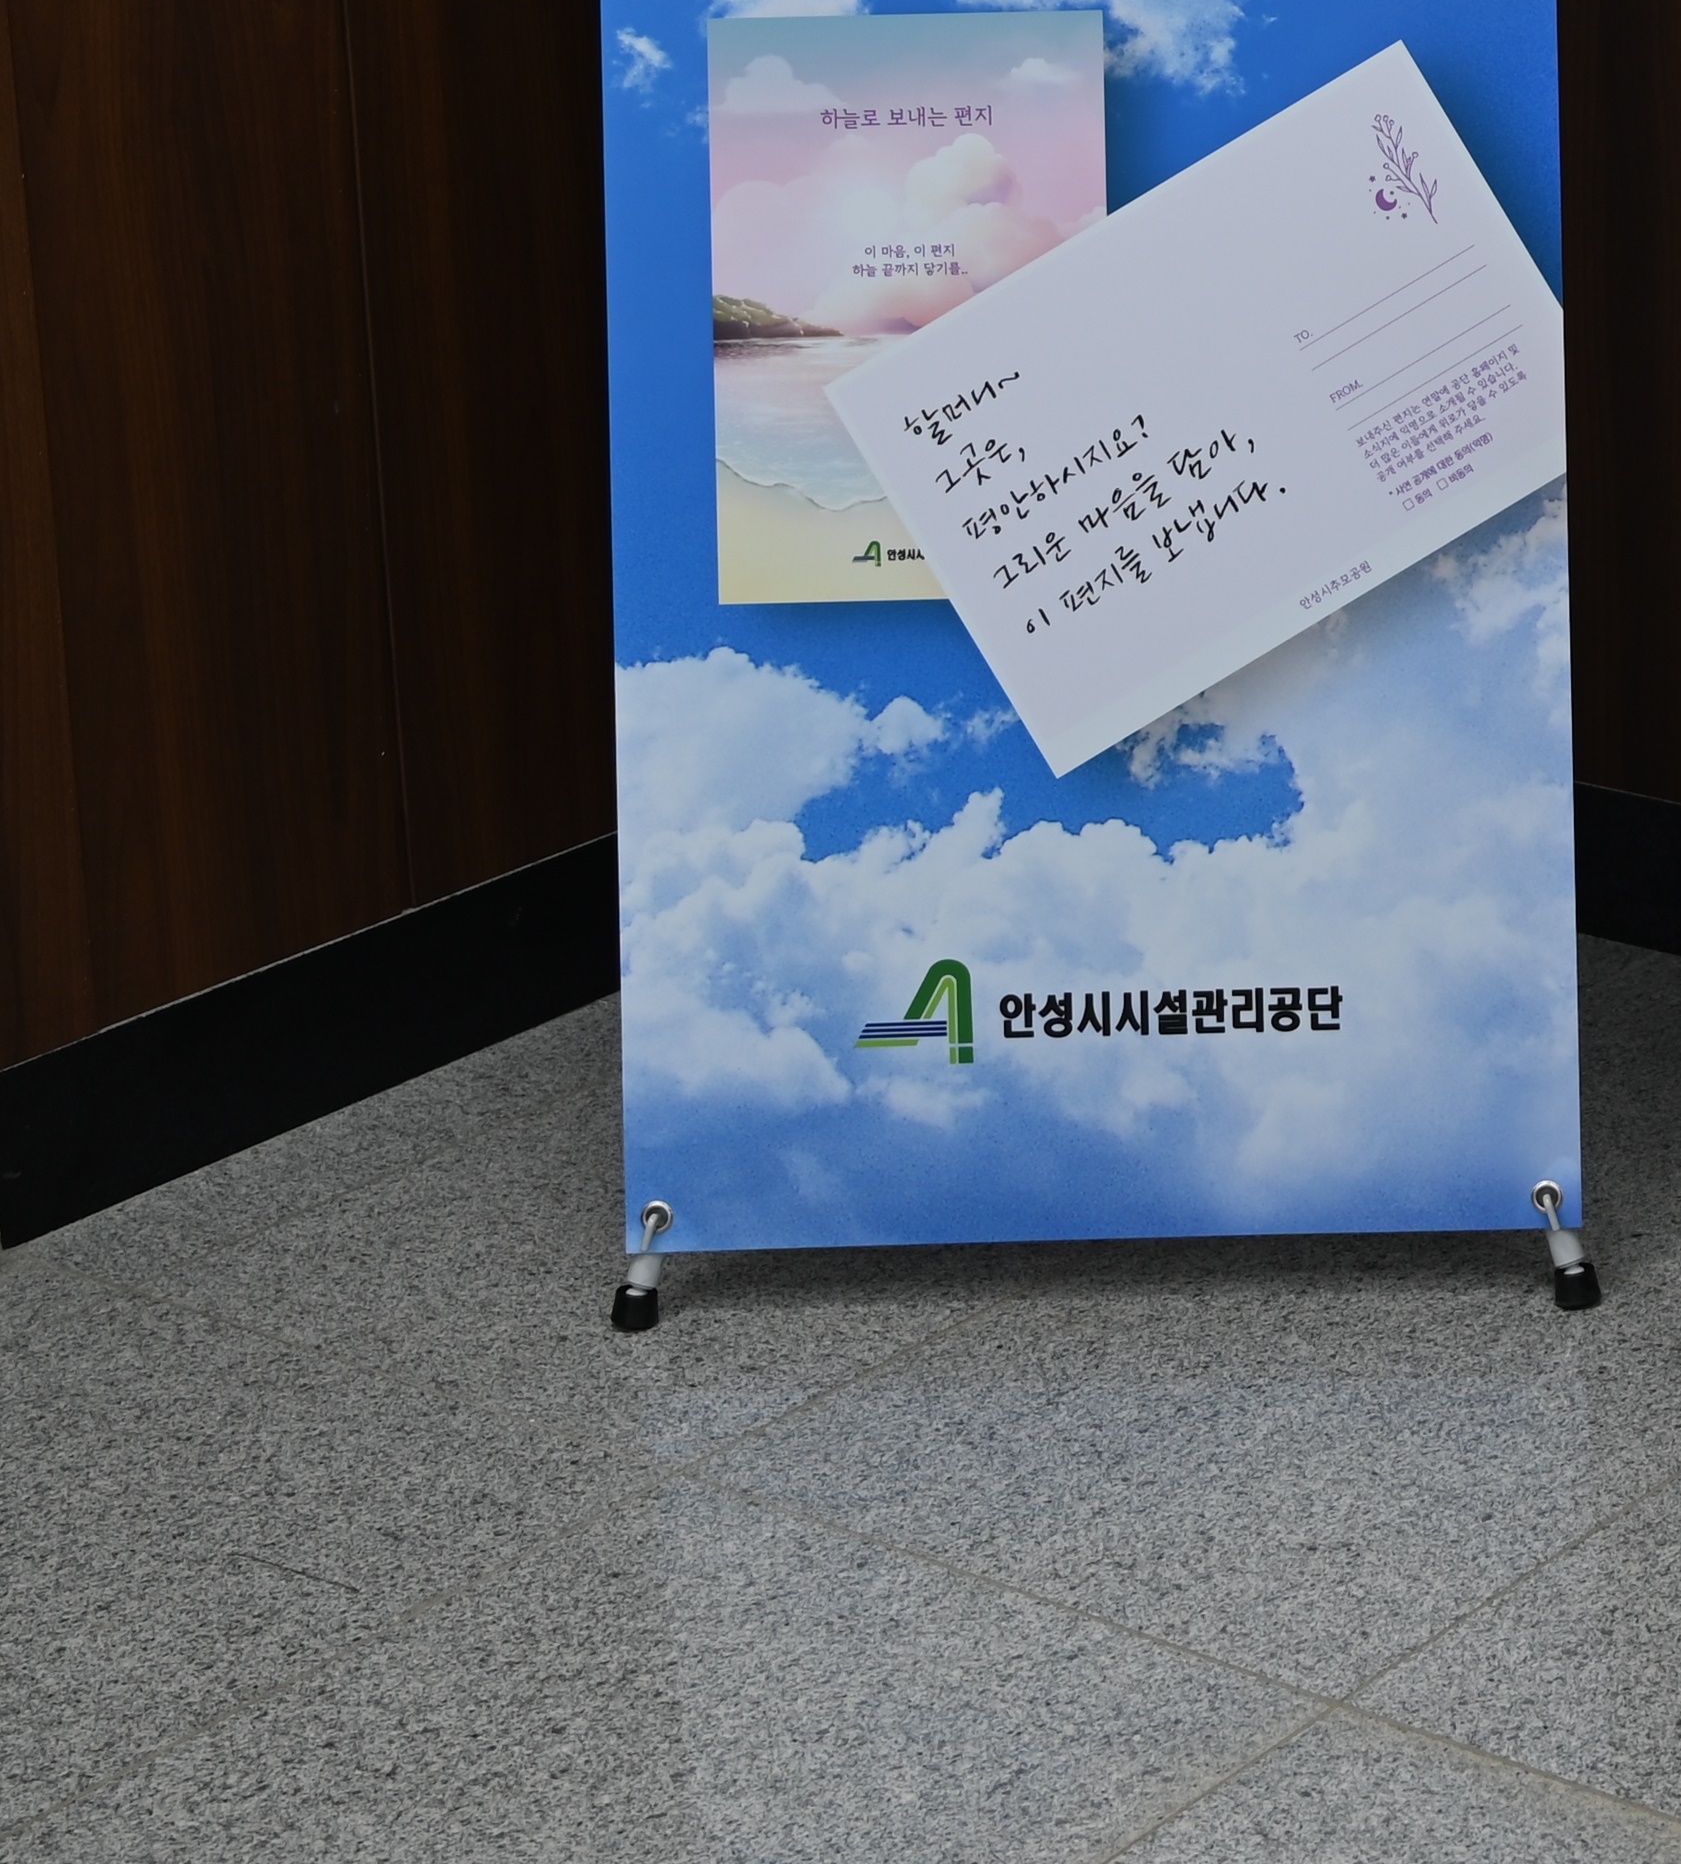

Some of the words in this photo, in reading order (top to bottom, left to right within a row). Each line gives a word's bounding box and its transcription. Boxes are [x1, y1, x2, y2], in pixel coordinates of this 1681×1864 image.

[818, 106, 883, 131] 하늘로
[885, 104, 949, 129] 보내는
[952, 103, 994, 128] 편지
[863, 243, 878, 261] 이
[879, 243, 911, 261] 마음,
[912, 242, 927, 260] 이
[929, 241, 956, 259] 편지
[1292, 329, 1314, 344] TO.
[934, 437, 1027, 495] 그곳은,
[960, 413, 1150, 541] 평안하시지요?
[991, 530, 1073, 591] 그리운
[1076, 471, 1173, 535] 마음을
[1165, 427, 1256, 481] 담아,
[1025, 607, 1052, 635] 이
[1057, 544, 1154, 614] 편지를
[1150, 478, 1288, 564] 보냅니다.
[1298, 559, 1373, 610] 안성시추모공원
[998, 984, 1344, 1040] 안성시시설관리공단
